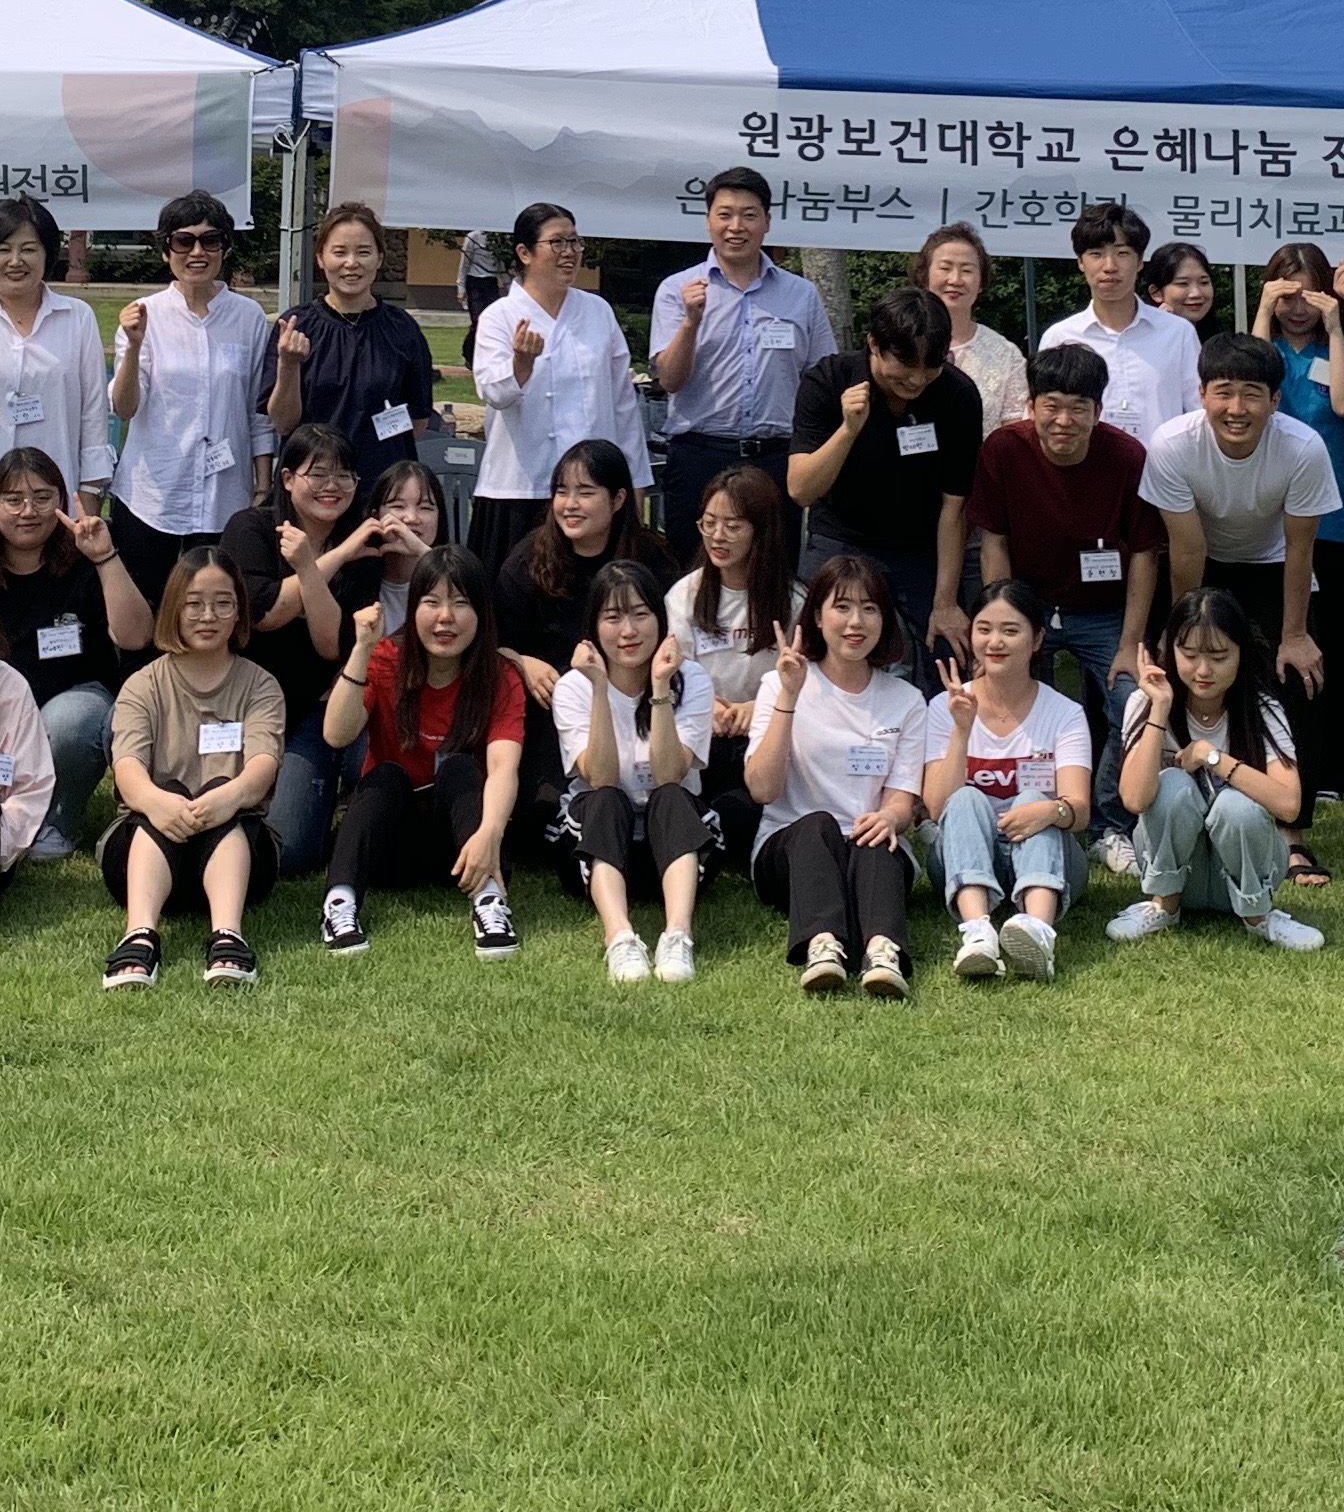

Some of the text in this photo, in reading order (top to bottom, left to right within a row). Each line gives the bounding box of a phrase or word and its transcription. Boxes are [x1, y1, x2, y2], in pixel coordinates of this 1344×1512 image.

[739, 111, 1081, 169] 원광보건대학교
[1104, 125, 1298, 178] 은혜나눔
[676, 178, 915, 224] 은나눔부스
